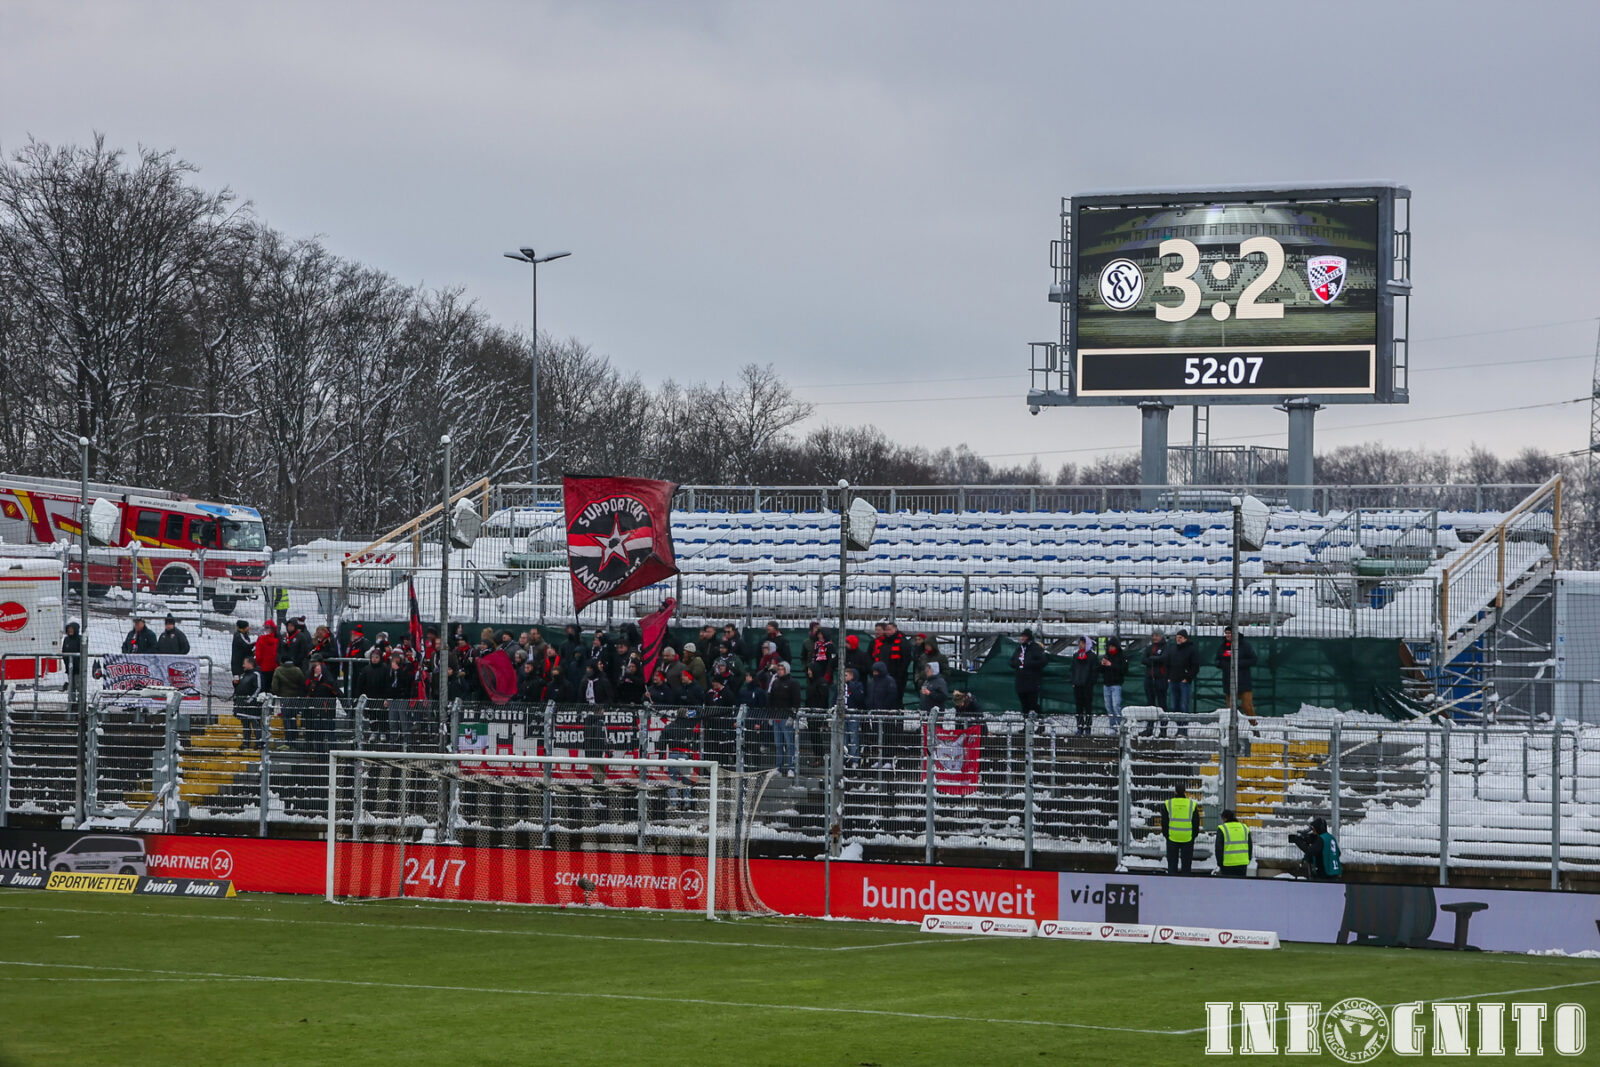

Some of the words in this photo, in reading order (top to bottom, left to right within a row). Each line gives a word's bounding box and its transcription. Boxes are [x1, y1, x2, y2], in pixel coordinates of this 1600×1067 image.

[1184, 356, 1264, 385] 52:07
[578, 498, 648, 528] SUPPORTERS
[106, 664, 150, 677] TORKEL
[556, 711, 633, 723] SUPPTERS
[555, 731, 633, 744] INGOADT
[145, 854, 209, 870] NPARTNER
[214, 857, 229, 870] 24
[10, 872, 42, 886] bwin
[405, 857, 466, 888] 24/7
[49, 875, 135, 891] SPORTWETTEN
[143, 880, 178, 893] bwin
[184, 881, 219, 895] bwin
[683, 877, 700, 891] 24
[862, 877, 1036, 915] bundesweit
[1070, 884, 1137, 905] viasit
